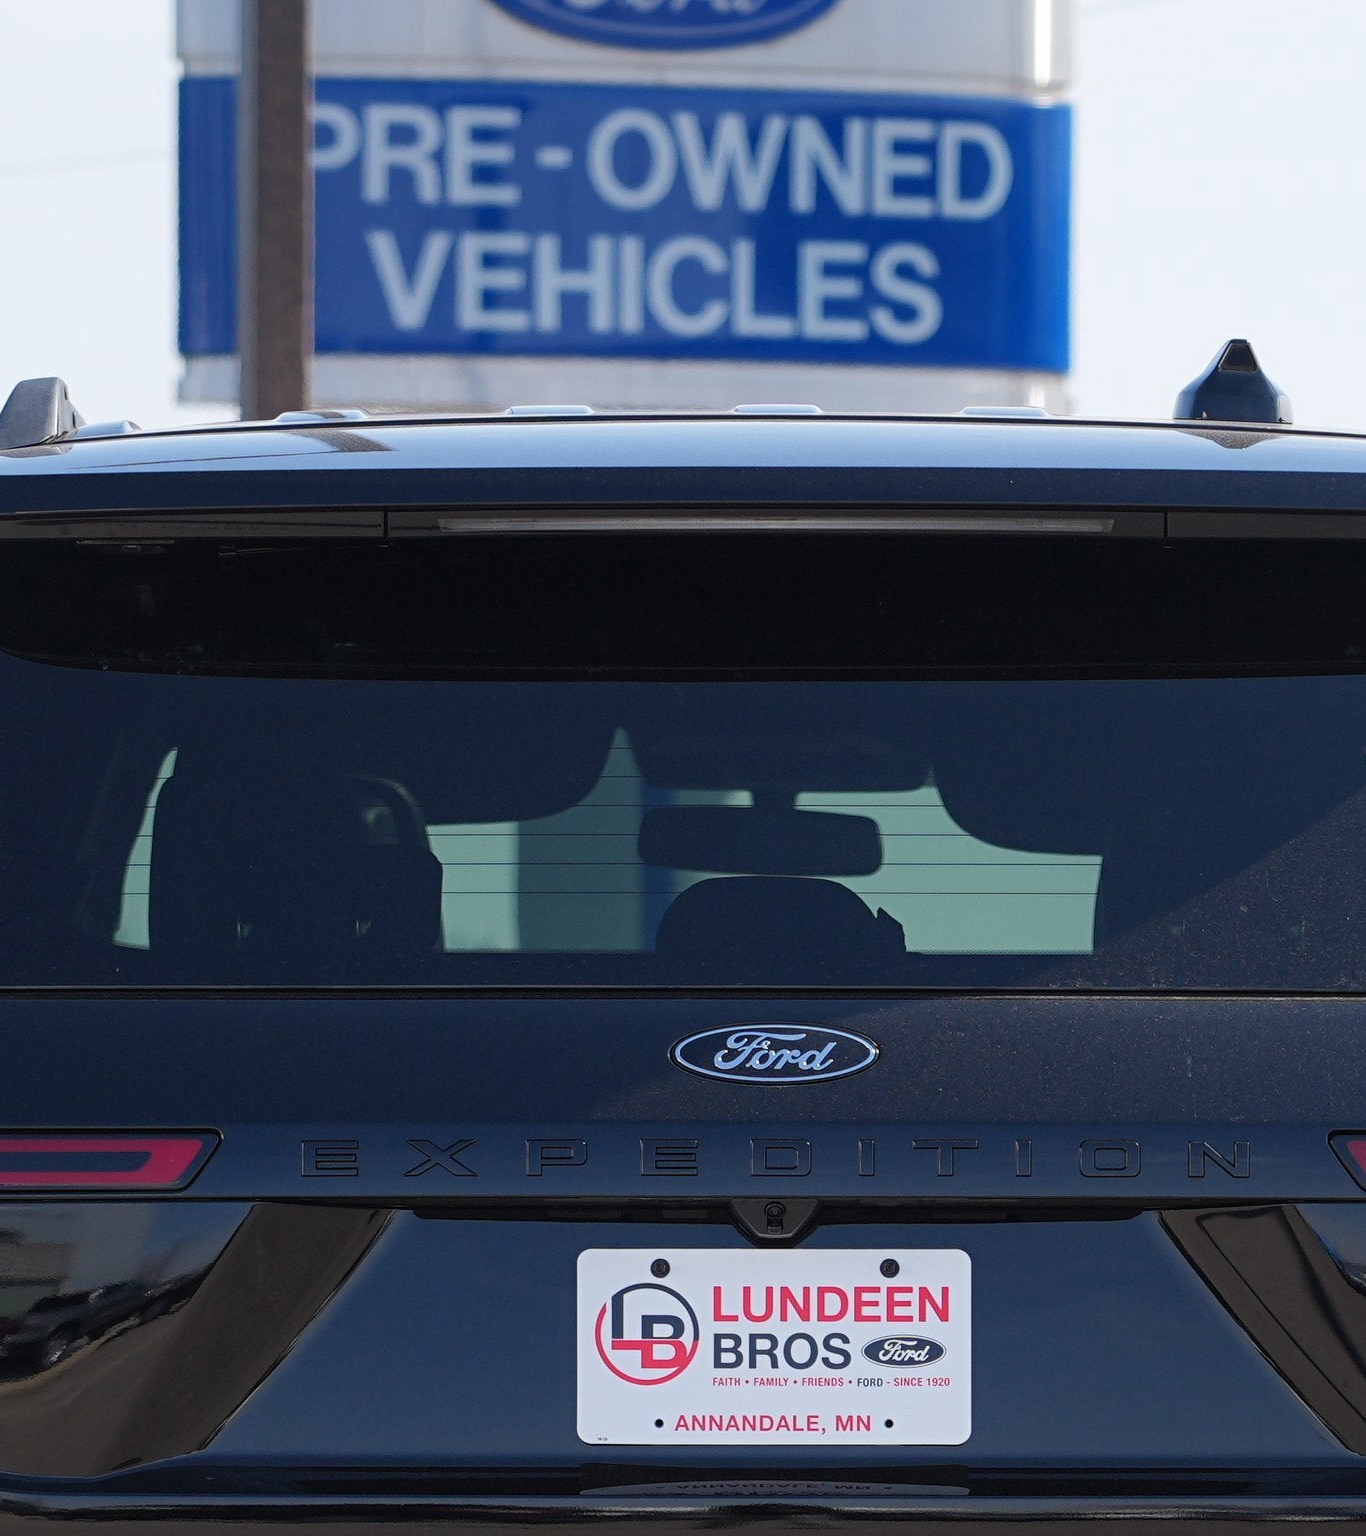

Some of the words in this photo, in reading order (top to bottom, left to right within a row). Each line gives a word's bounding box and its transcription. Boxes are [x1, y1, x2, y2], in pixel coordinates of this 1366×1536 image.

[367, 230, 943, 343] VEHICLES
[714, 1031, 837, 1070] Ford
[300, 1138, 1252, 1180] EXPEDITION
[712, 1286, 950, 1323] LUNDEEN
[712, 1332, 852, 1370] BROS
[712, 1377, 741, 1387] FAITH
[753, 1377, 789, 1387] FAMILY
[801, 1377, 845, 1387] FRIENDS
[856, 1377, 884, 1388] FORD
[893, 1377, 923, 1387] SINCE
[926, 1377, 951, 1387] 1920
[674, 1414, 826, 1435] ANNANDALE,
[835, 1414, 872, 1432] MN
